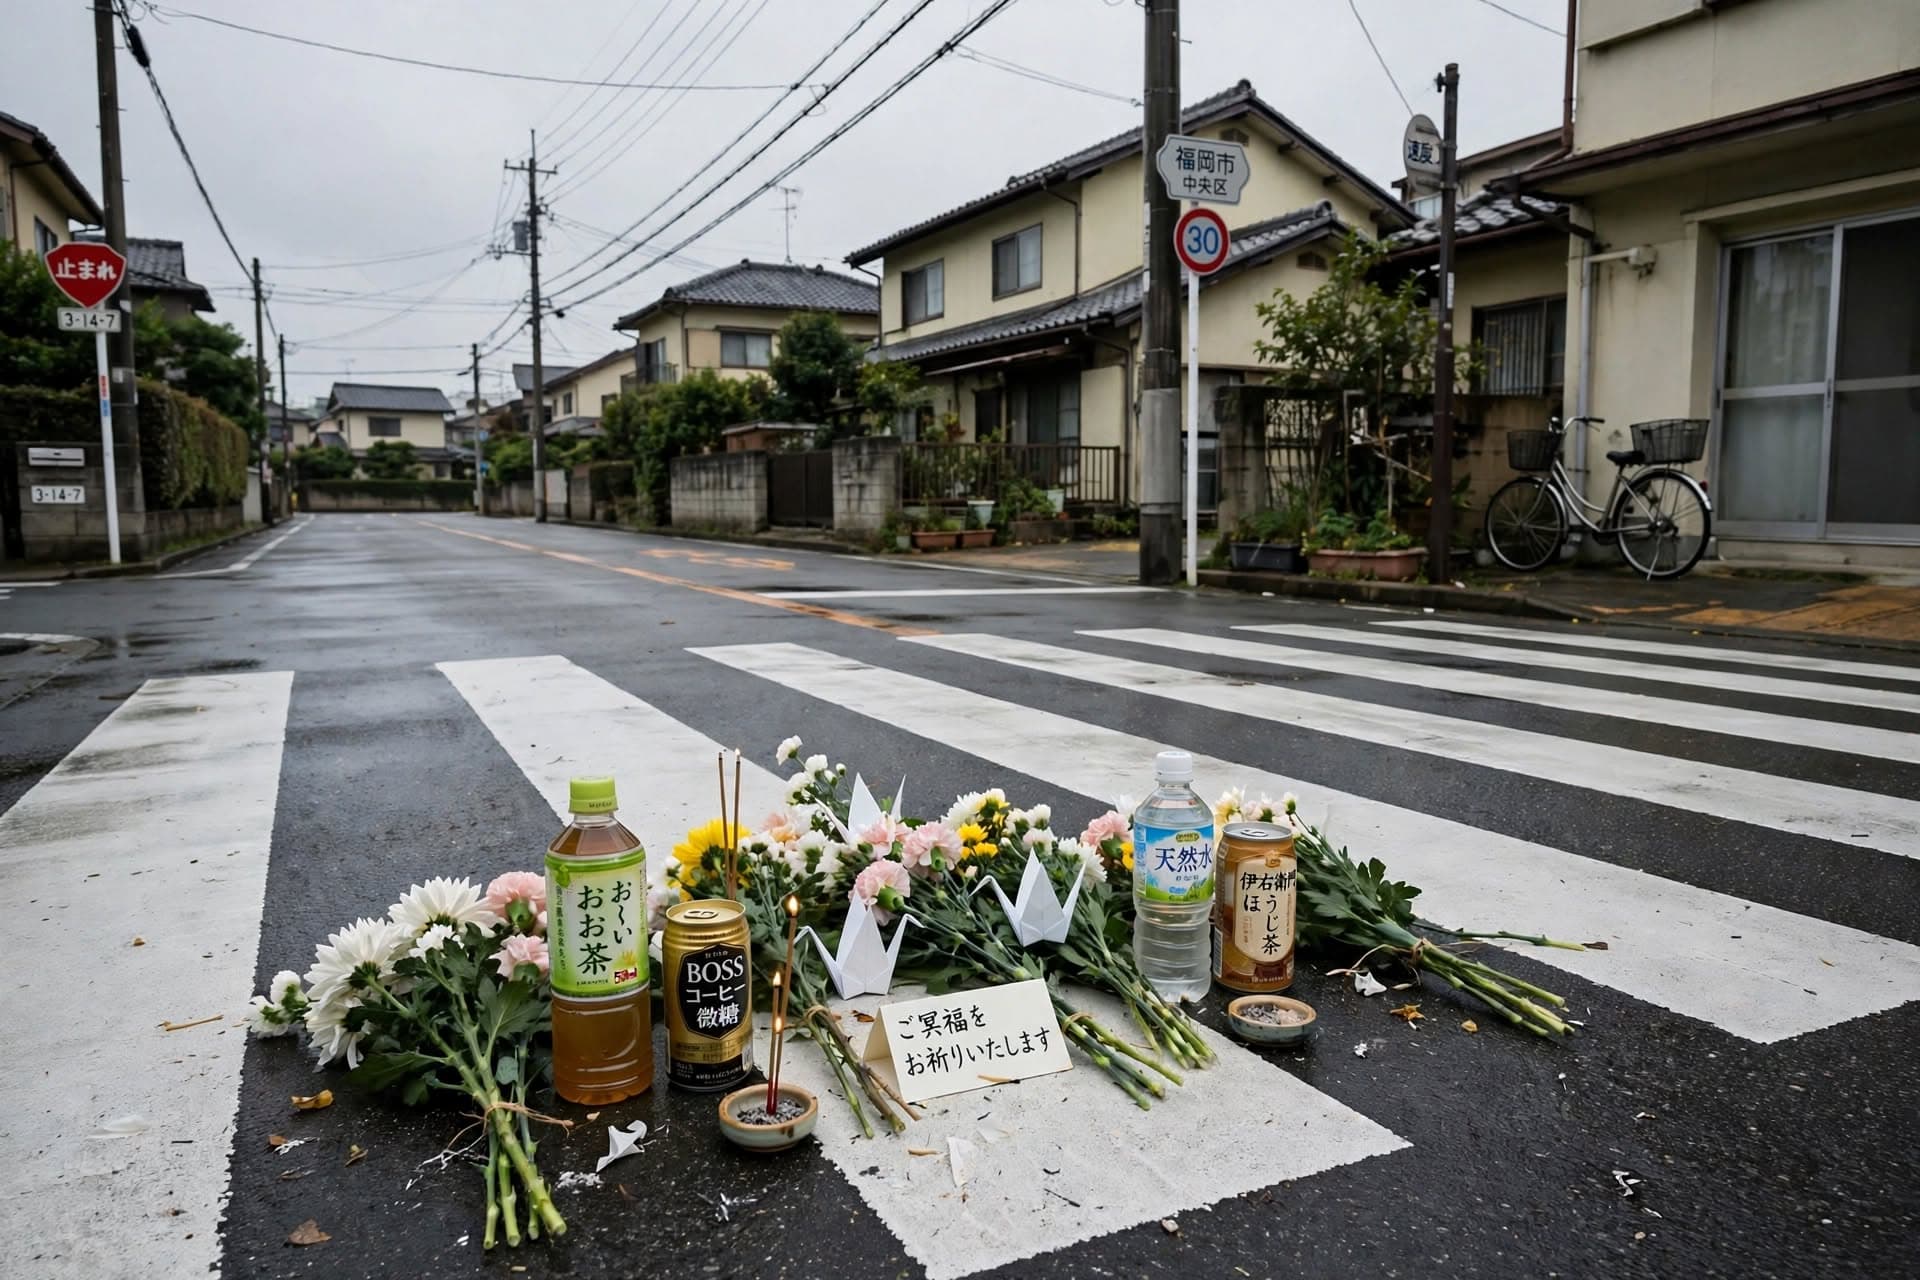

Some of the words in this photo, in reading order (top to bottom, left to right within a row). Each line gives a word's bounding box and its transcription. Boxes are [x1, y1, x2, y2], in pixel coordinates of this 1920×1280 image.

[1176, 146, 1236, 175] 福岡市
[1183, 175, 1228, 196] 中央区
[1187, 225, 1219, 255] 30
[55, 257, 117, 280] 止まれ
[64, 312, 115, 328] 3-14-7
[35, 488, 81, 502] 3-14-7
[1154, 843, 1212, 872] 天然水
[577, 885, 613, 975] おお茶
[686, 955, 744, 983] BOSS
[686, 983, 746, 1003] コーヒー
[696, 1002, 740, 1029] 微糖
[898, 1004, 986, 1040] ご冥福を
[905, 1026, 1050, 1076] お祈りいたします
